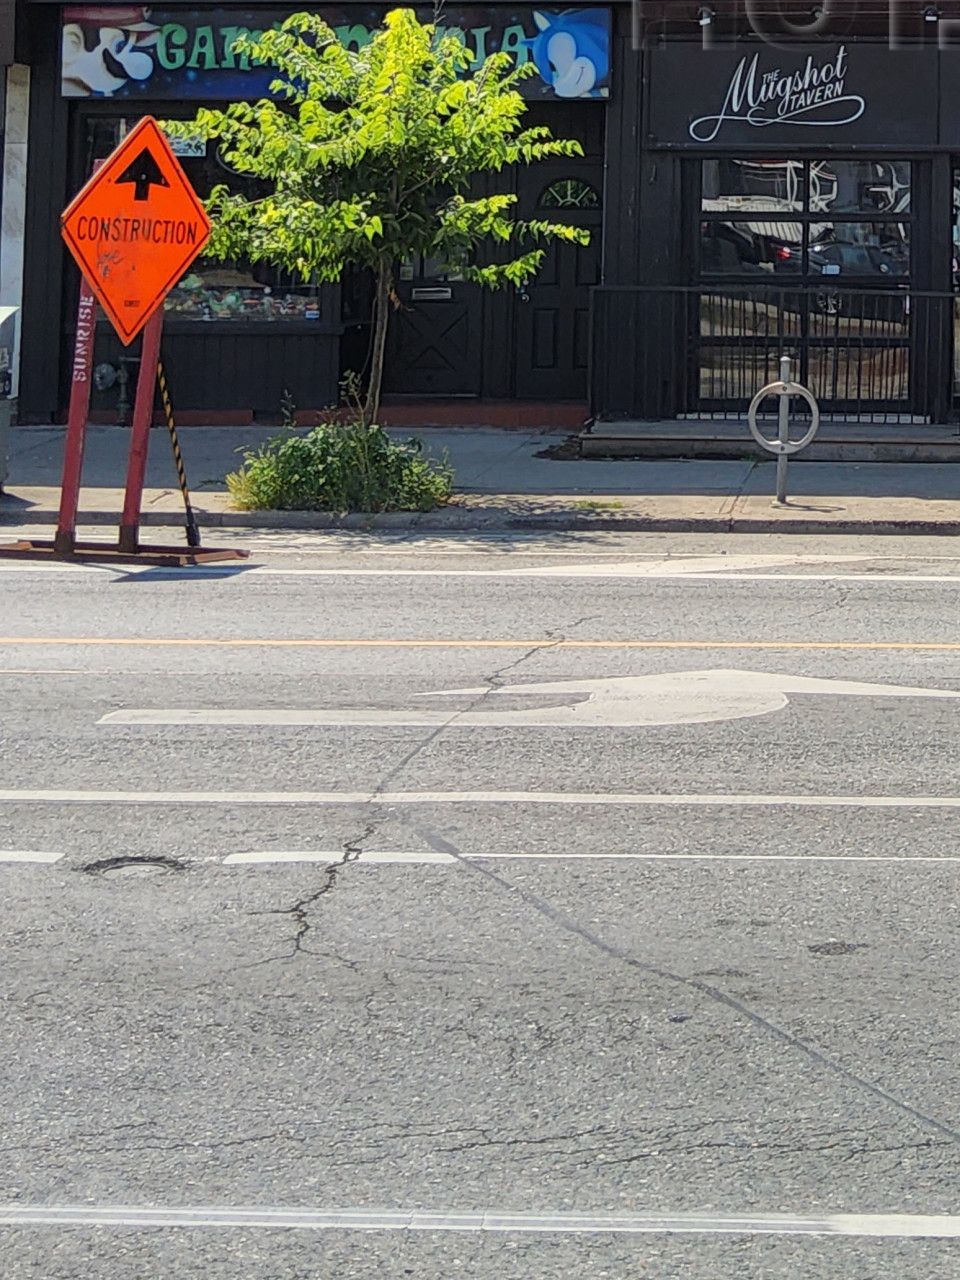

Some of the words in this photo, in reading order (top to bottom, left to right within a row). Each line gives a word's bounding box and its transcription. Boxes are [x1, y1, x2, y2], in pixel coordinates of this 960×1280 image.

[708, 45, 850, 132] Mugshot
[762, 69, 781, 83] THE
[789, 80, 845, 112] TAVERN
[77, 215, 198, 245] CONSTRUCTION
[73, 295, 95, 383] SUNRISE
